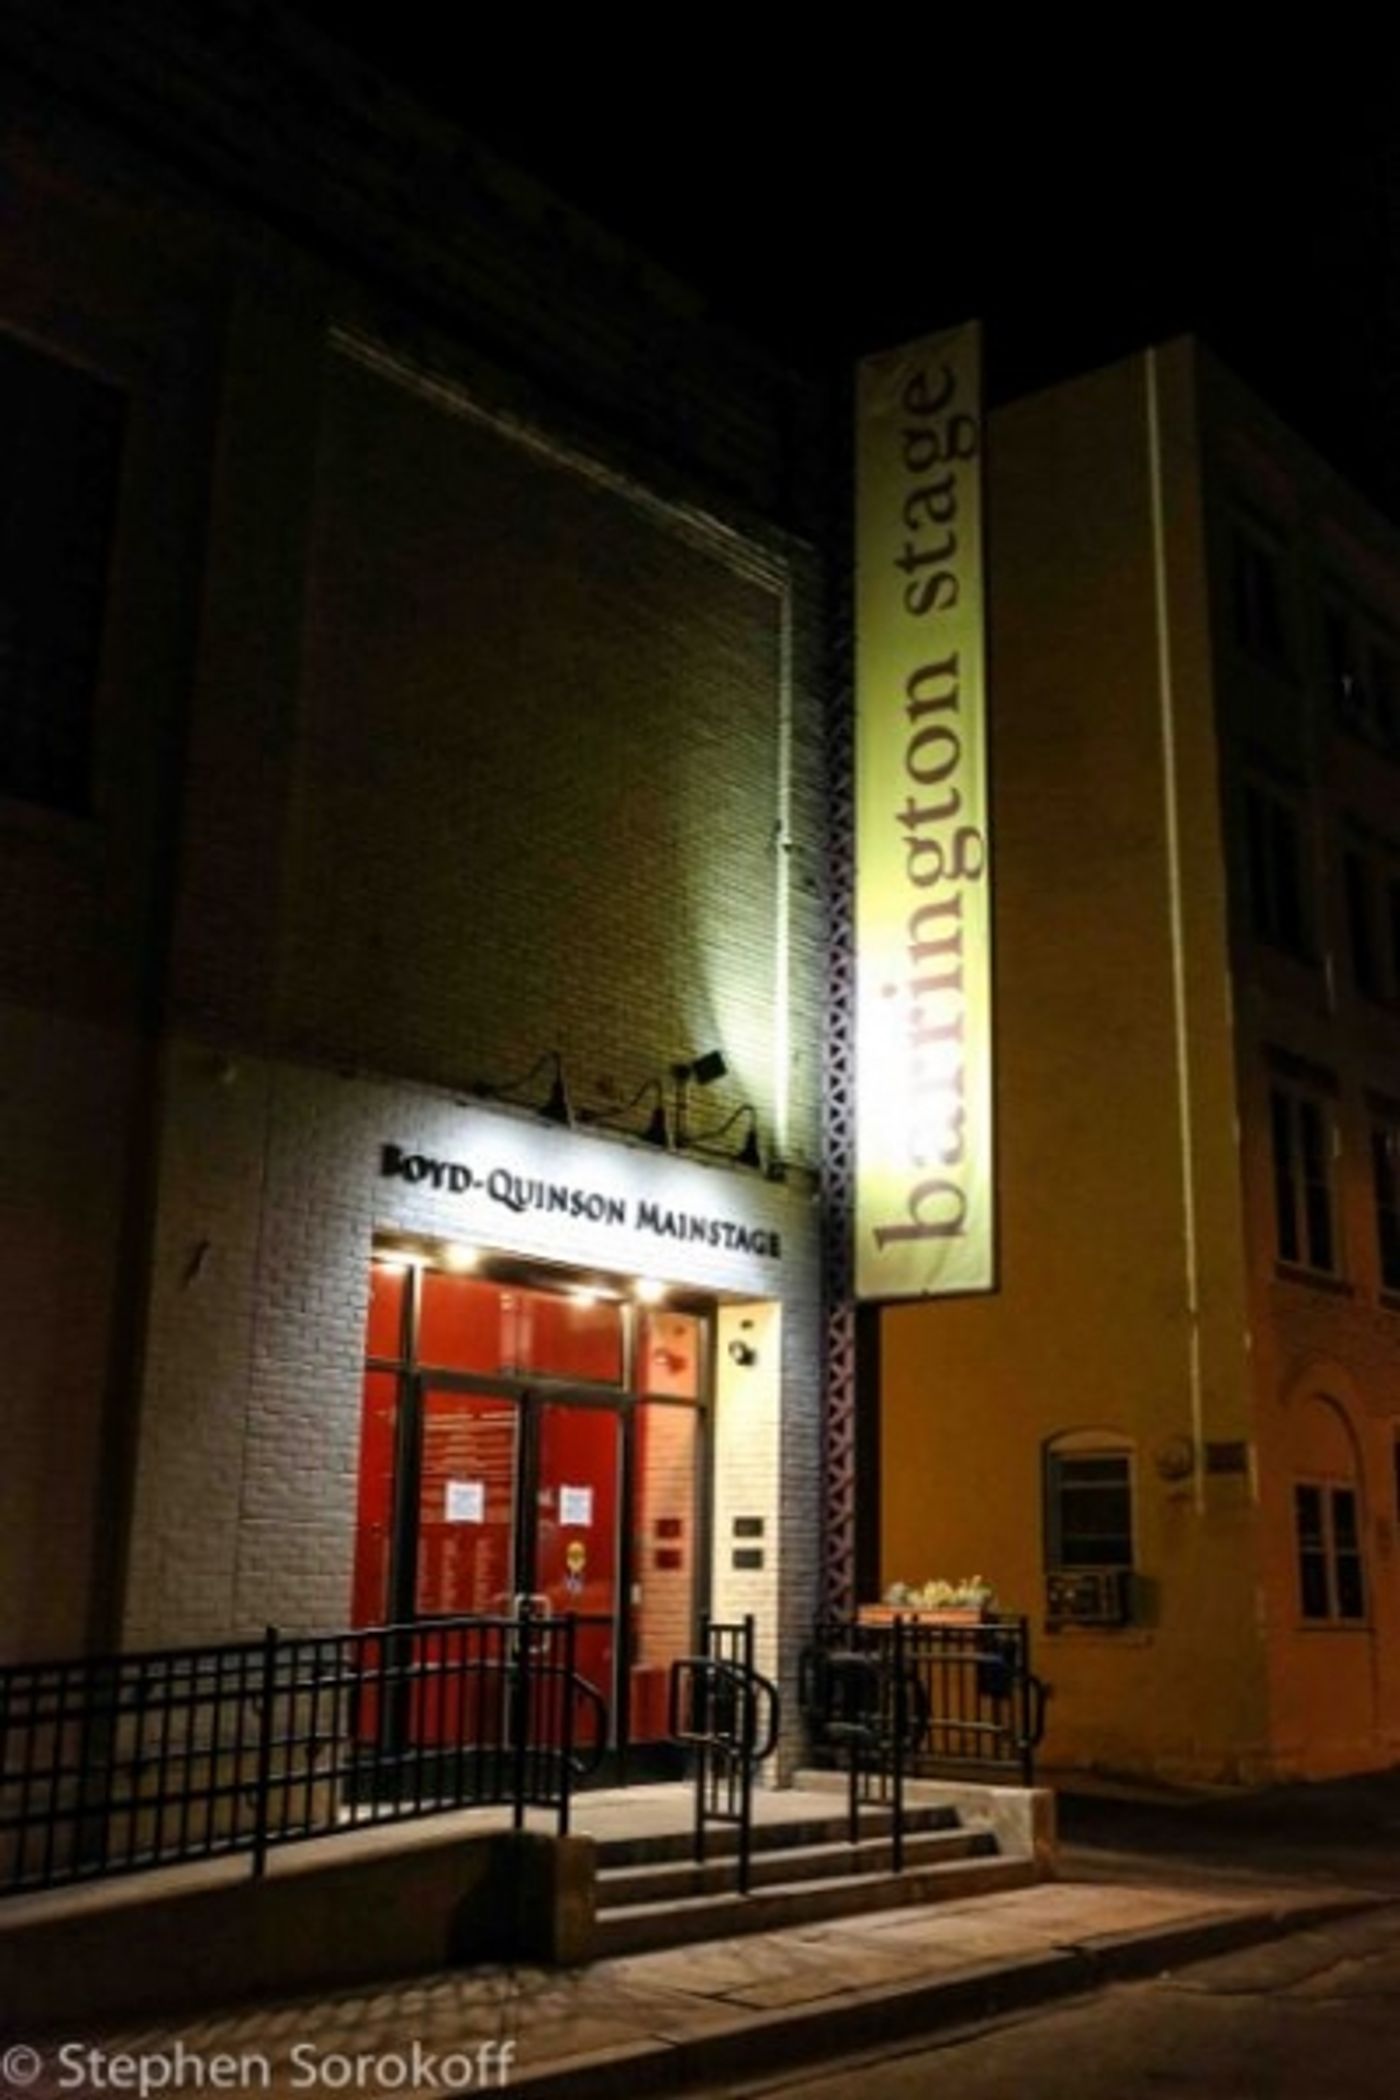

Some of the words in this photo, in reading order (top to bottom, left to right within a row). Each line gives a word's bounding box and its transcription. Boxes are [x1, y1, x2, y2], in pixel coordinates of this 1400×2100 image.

[895, 363, 977, 617] stage
[872, 651, 984, 1251] barrington
[636, 1200, 782, 1258] MAINSTAGE
